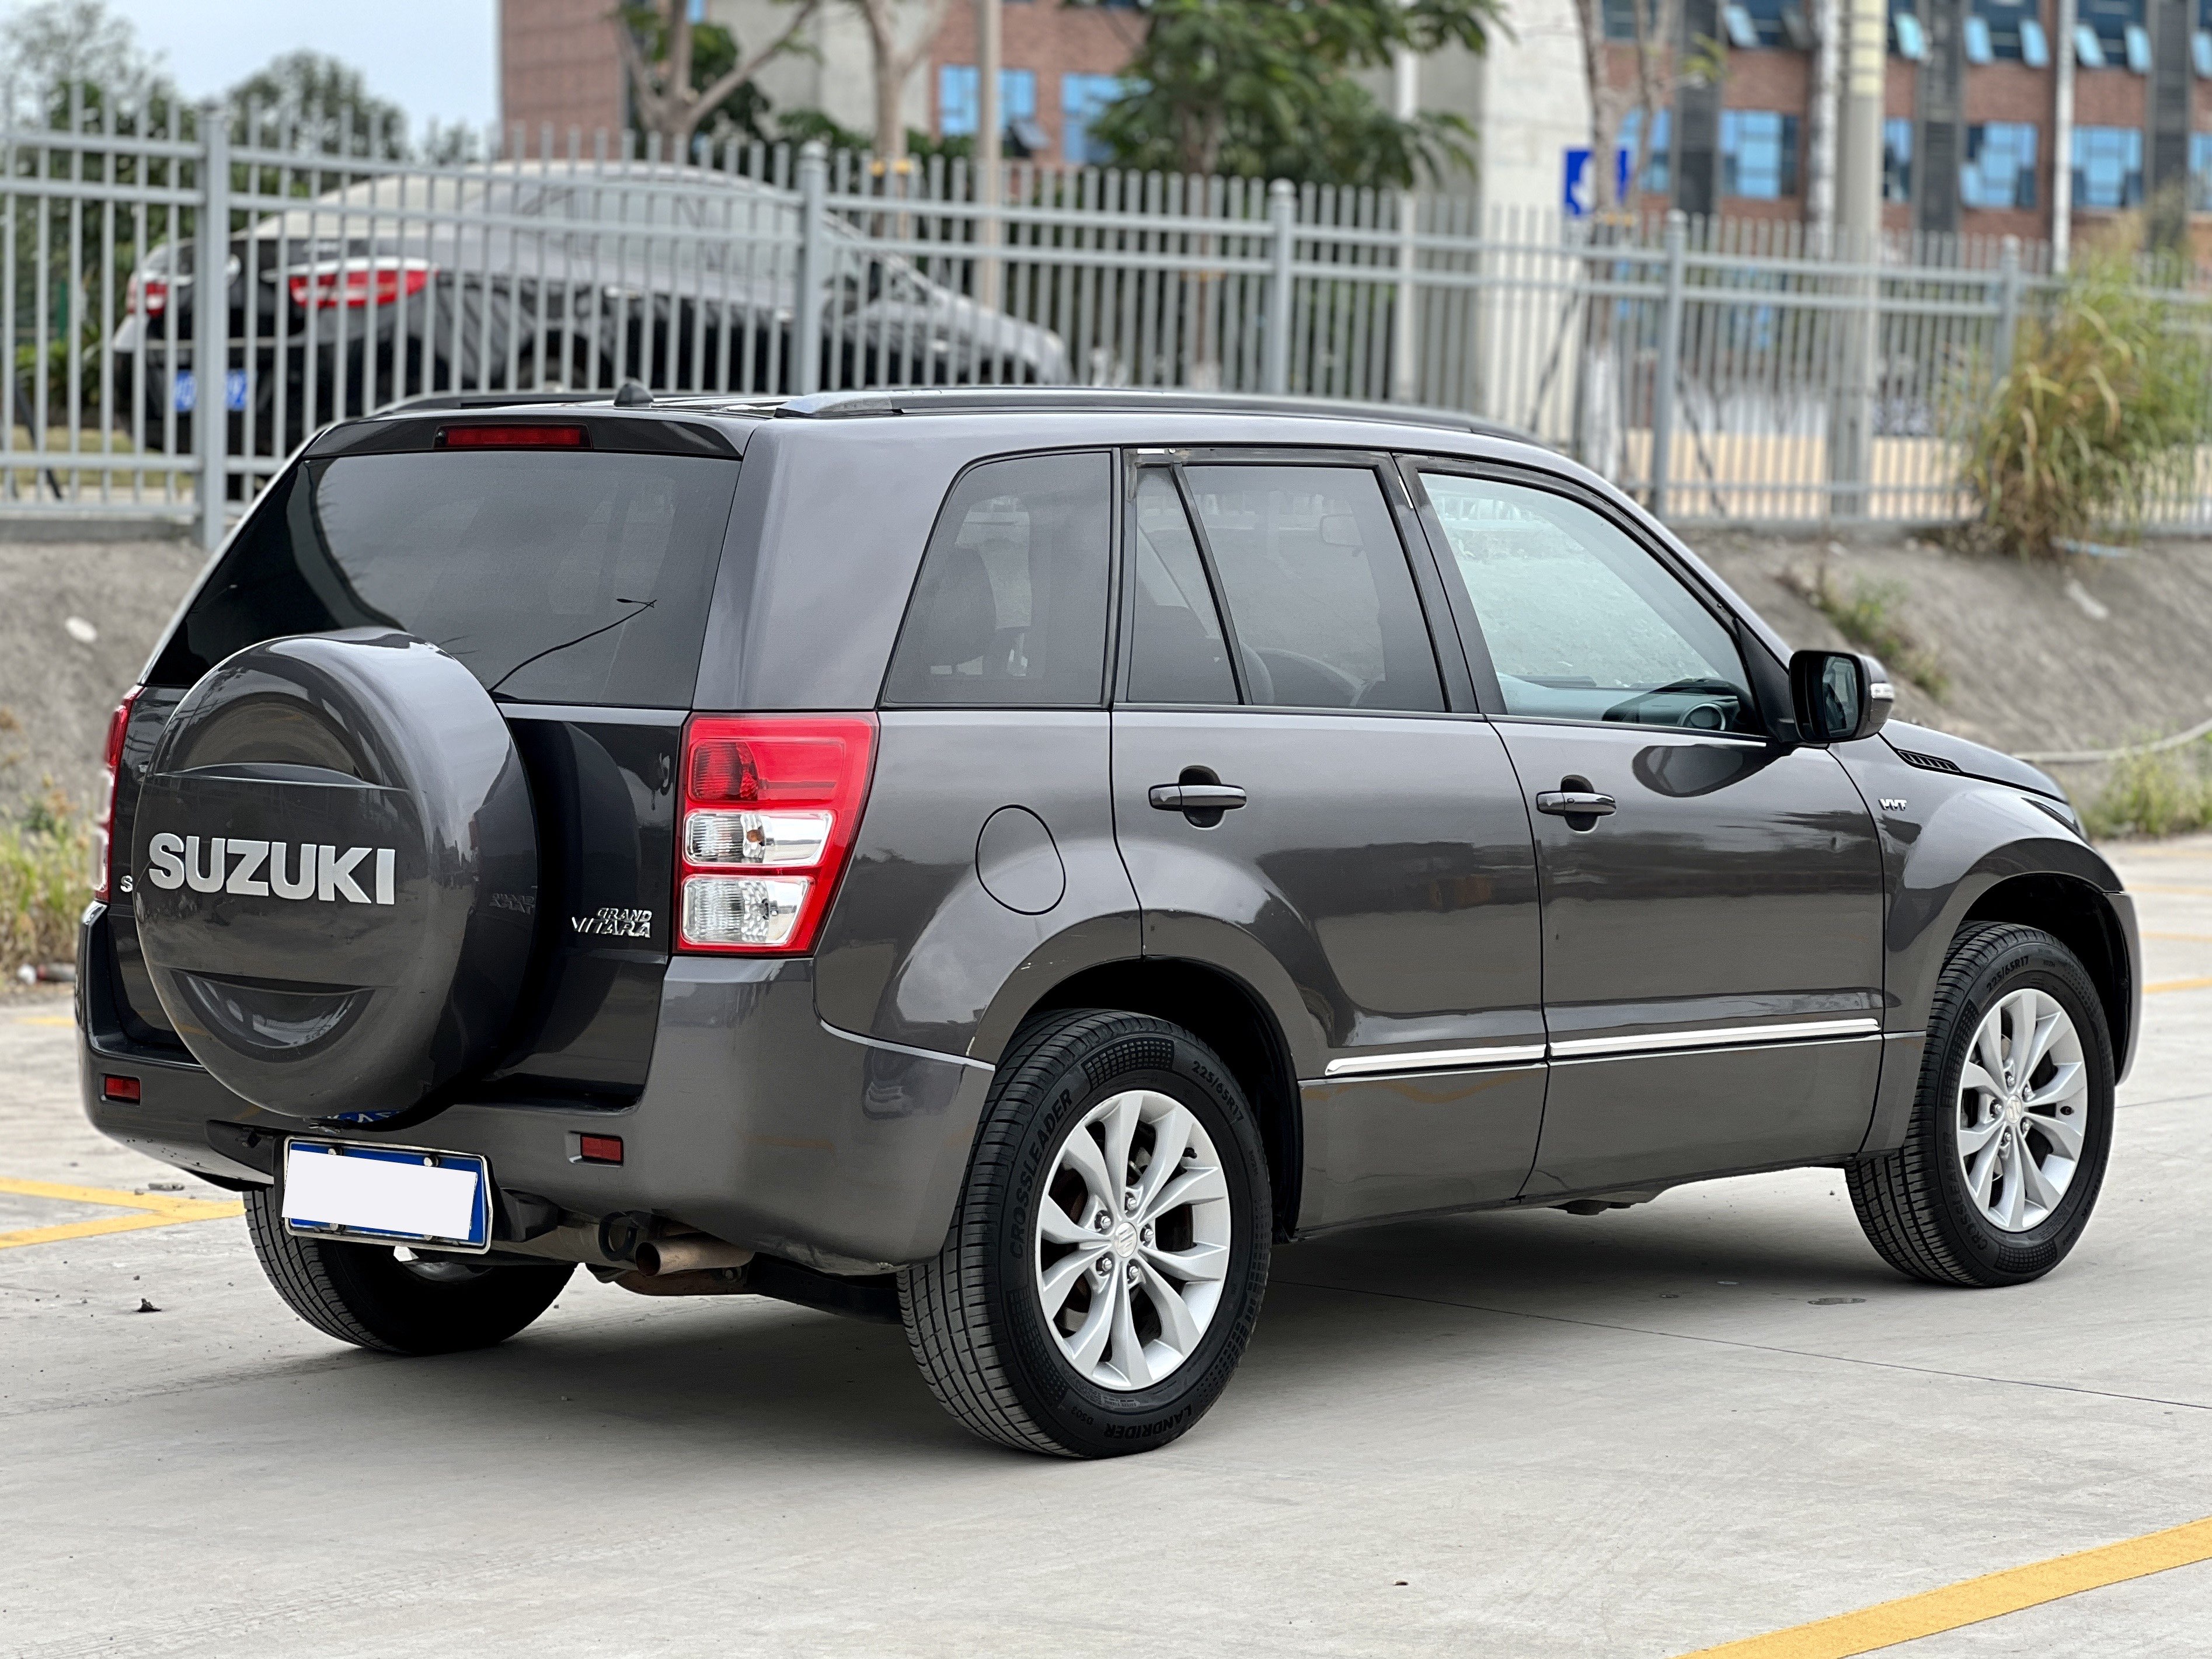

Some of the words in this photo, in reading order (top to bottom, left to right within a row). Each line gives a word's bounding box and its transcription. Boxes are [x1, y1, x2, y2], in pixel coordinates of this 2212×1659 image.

[149, 832, 396, 905] SUZUKI
[572, 916, 651, 938] VITARA
[597, 907, 652, 922] GRAND
[1986, 956, 2029, 991] 225/65R17
[1192, 1060, 1244, 1122] 225/65R17
[1010, 1088, 1073, 1260] CROSSLEADER
[1102, 1404, 1193, 1439] LANDRIDER
